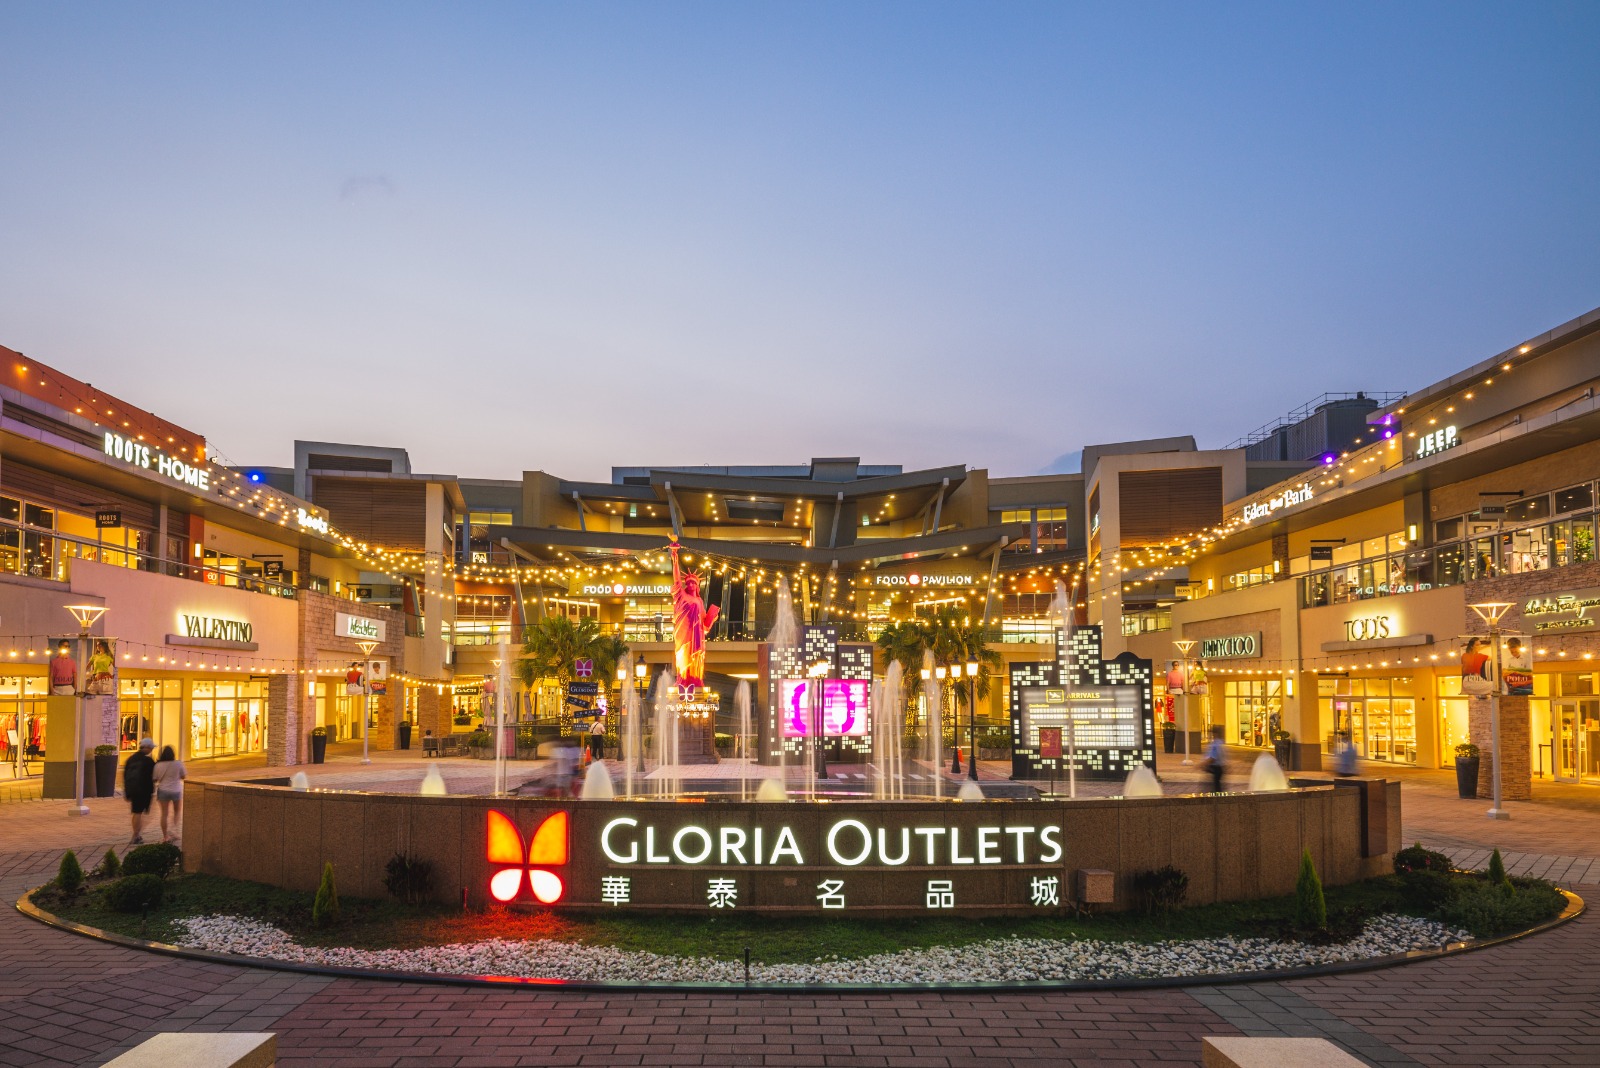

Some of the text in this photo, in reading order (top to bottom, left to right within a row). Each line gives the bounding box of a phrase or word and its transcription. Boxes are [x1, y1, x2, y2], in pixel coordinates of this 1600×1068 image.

[1417, 426, 1456, 454] JEEP
[105, 433, 208, 490] ROOTS HOME
[1244, 483, 1313, 523] Eden Park
[584, 585, 671, 594] FOOD PAVILION
[876, 576, 972, 584] FOOD PAVILION
[183, 615, 252, 642] VALENTINO
[1344, 616, 1389, 641] TOD'S
[601, 818, 1062, 866] GLORIA OUTLETS
[601, 876, 1060, 908] 華泰名品城
